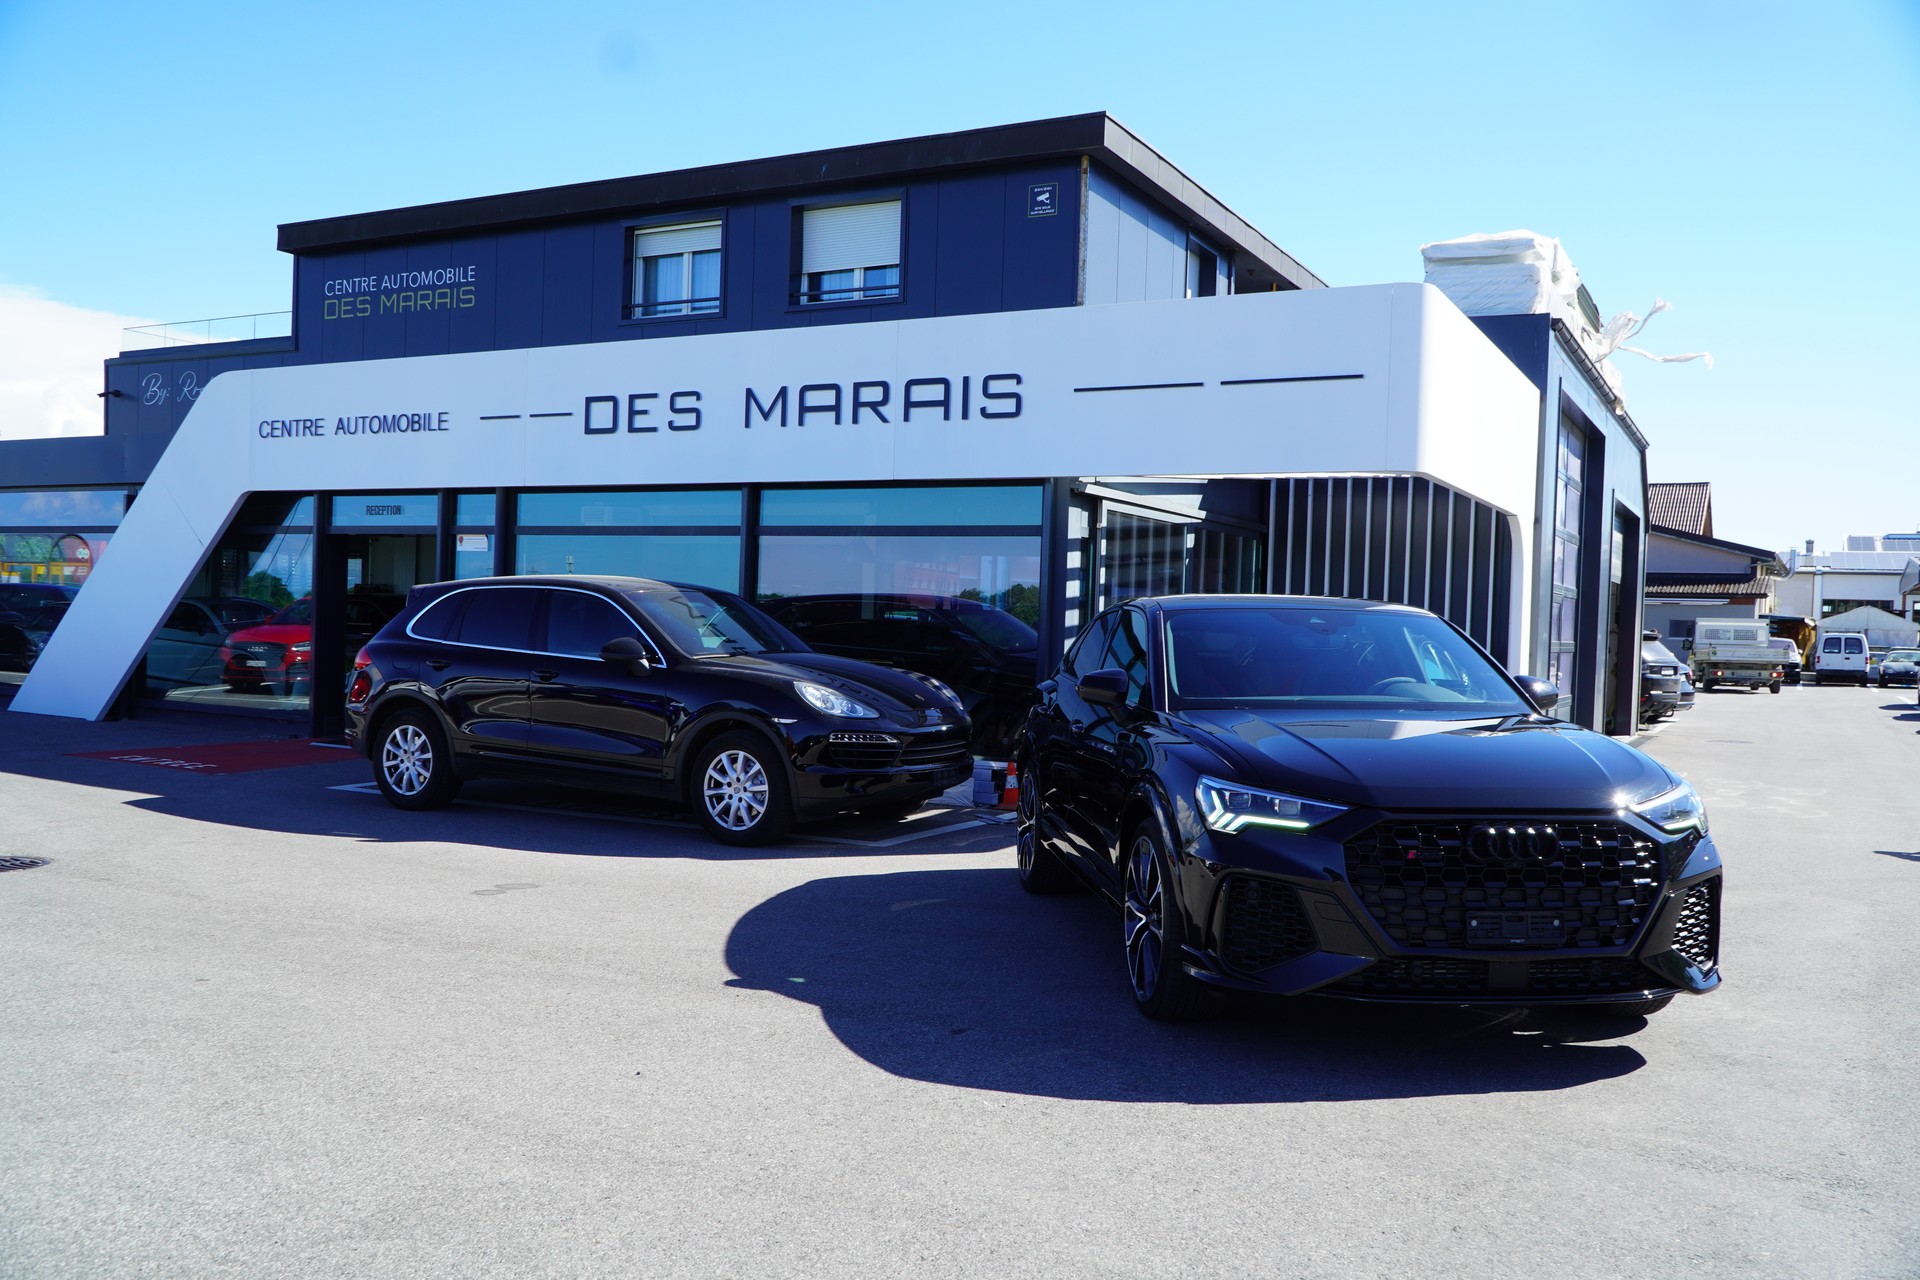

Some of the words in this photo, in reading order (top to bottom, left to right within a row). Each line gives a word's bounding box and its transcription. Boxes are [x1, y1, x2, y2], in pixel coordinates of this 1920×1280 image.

[324, 276, 377, 296] CENTRE
[381, 265, 476, 290] AUTOMOBILE
[324, 296, 371, 319] DES
[380, 286, 475, 314] MARAIS
[584, 390, 703, 435] DES
[744, 373, 1023, 429] MARAIS
[258, 418, 325, 439] CENTRE
[334, 411, 450, 436] AUTOMOBILE
